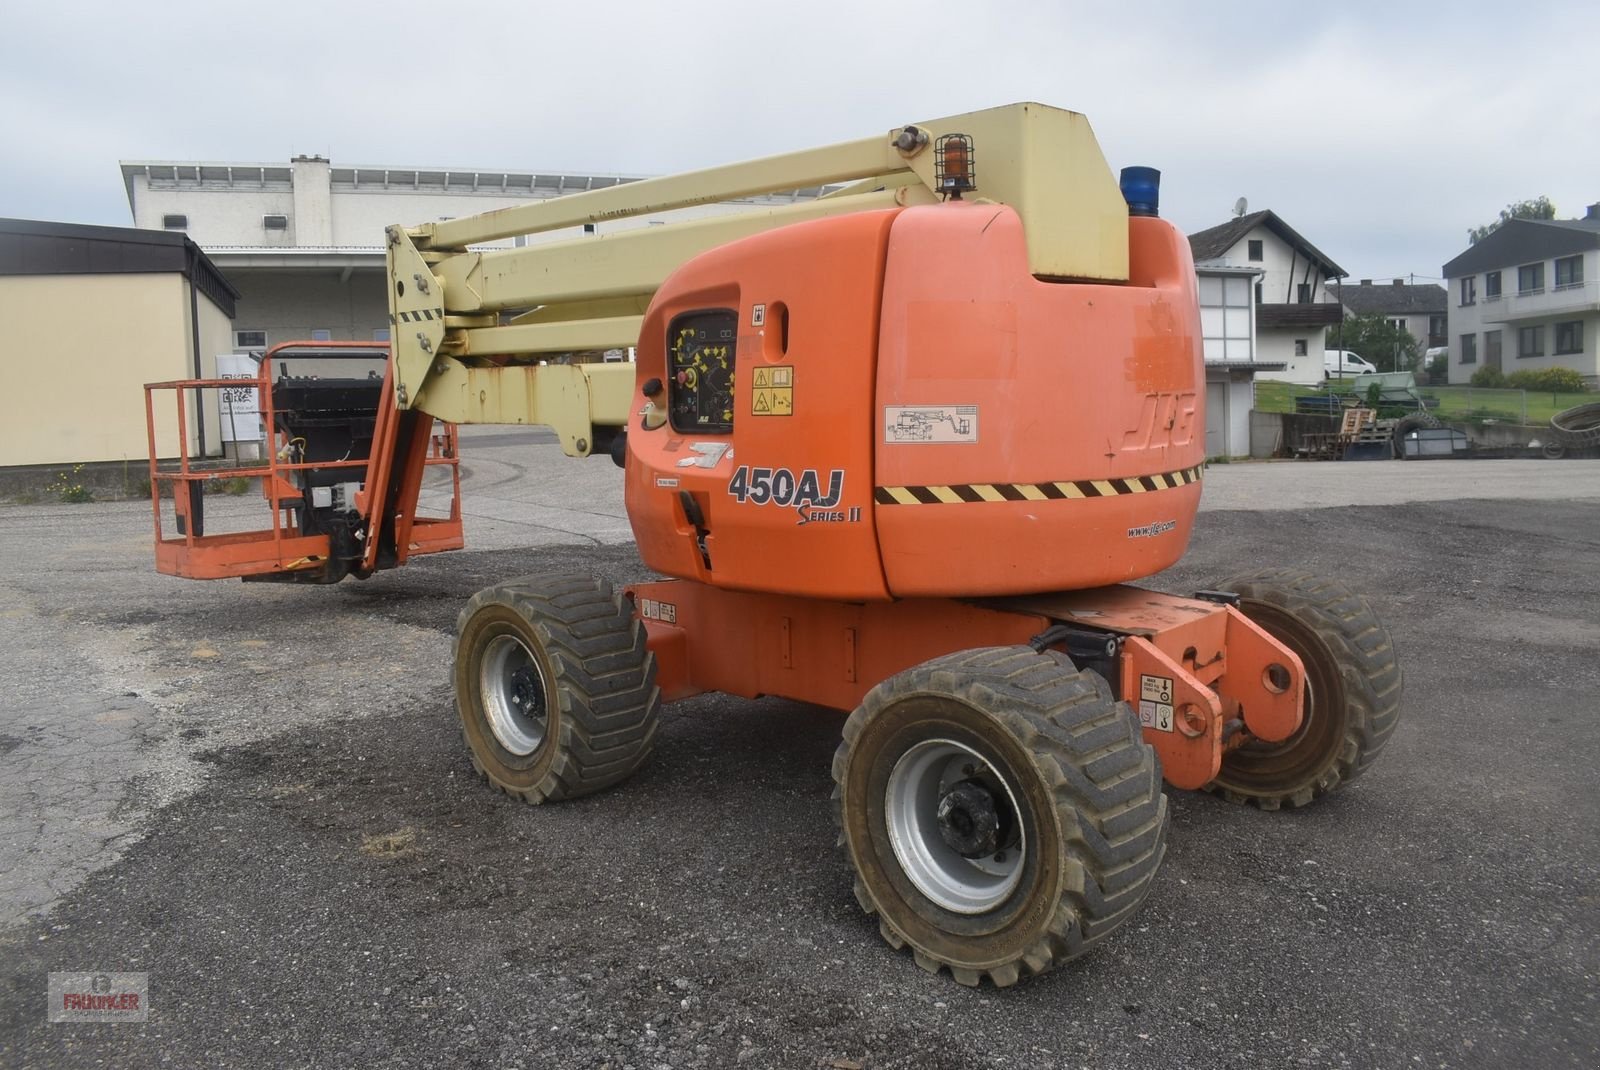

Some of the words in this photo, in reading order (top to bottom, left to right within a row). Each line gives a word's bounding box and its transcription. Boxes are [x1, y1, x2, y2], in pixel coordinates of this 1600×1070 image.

[1120, 392, 1196, 451] JLG
[728, 465, 845, 508] 450AJ
[1128, 519, 1176, 538] www.jlg.com
